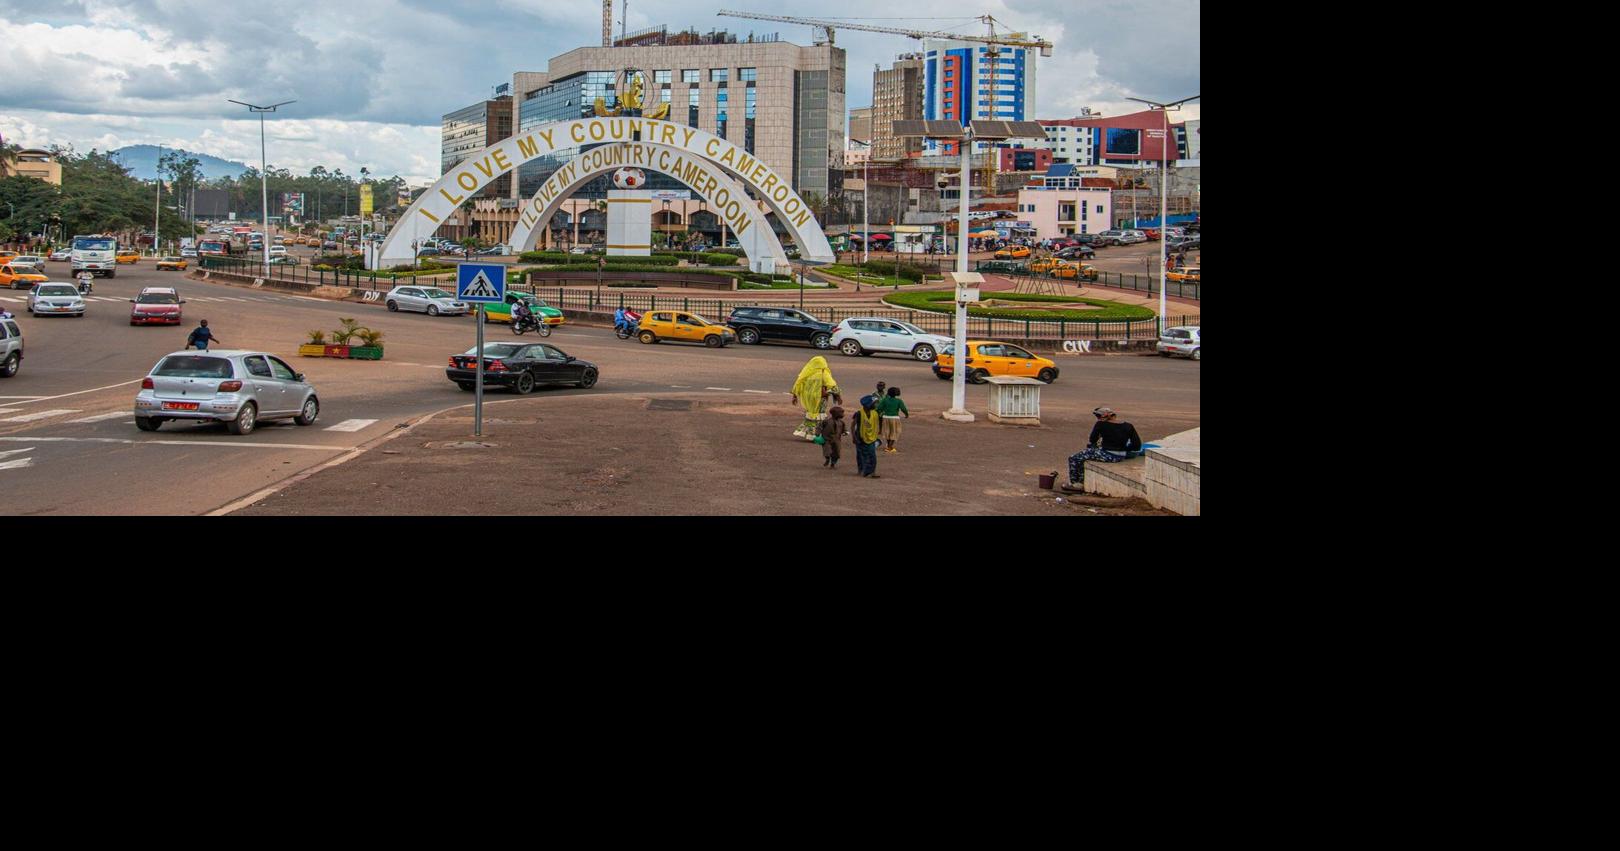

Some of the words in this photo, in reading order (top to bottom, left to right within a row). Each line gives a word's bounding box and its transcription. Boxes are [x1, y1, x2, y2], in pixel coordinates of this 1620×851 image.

[418, 208, 440, 224] I
[439, 148, 512, 206] LOVE
[516, 128, 554, 159] MY
[570, 118, 696, 148] COUNTRY
[705, 138, 812, 228] CAMEROON
[557, 161, 577, 189] MY
[582, 144, 657, 173] COUNTRY
[525, 178, 559, 224] LOVE
[659, 150, 752, 236] CAMEROON
[521, 218, 531, 230] I
